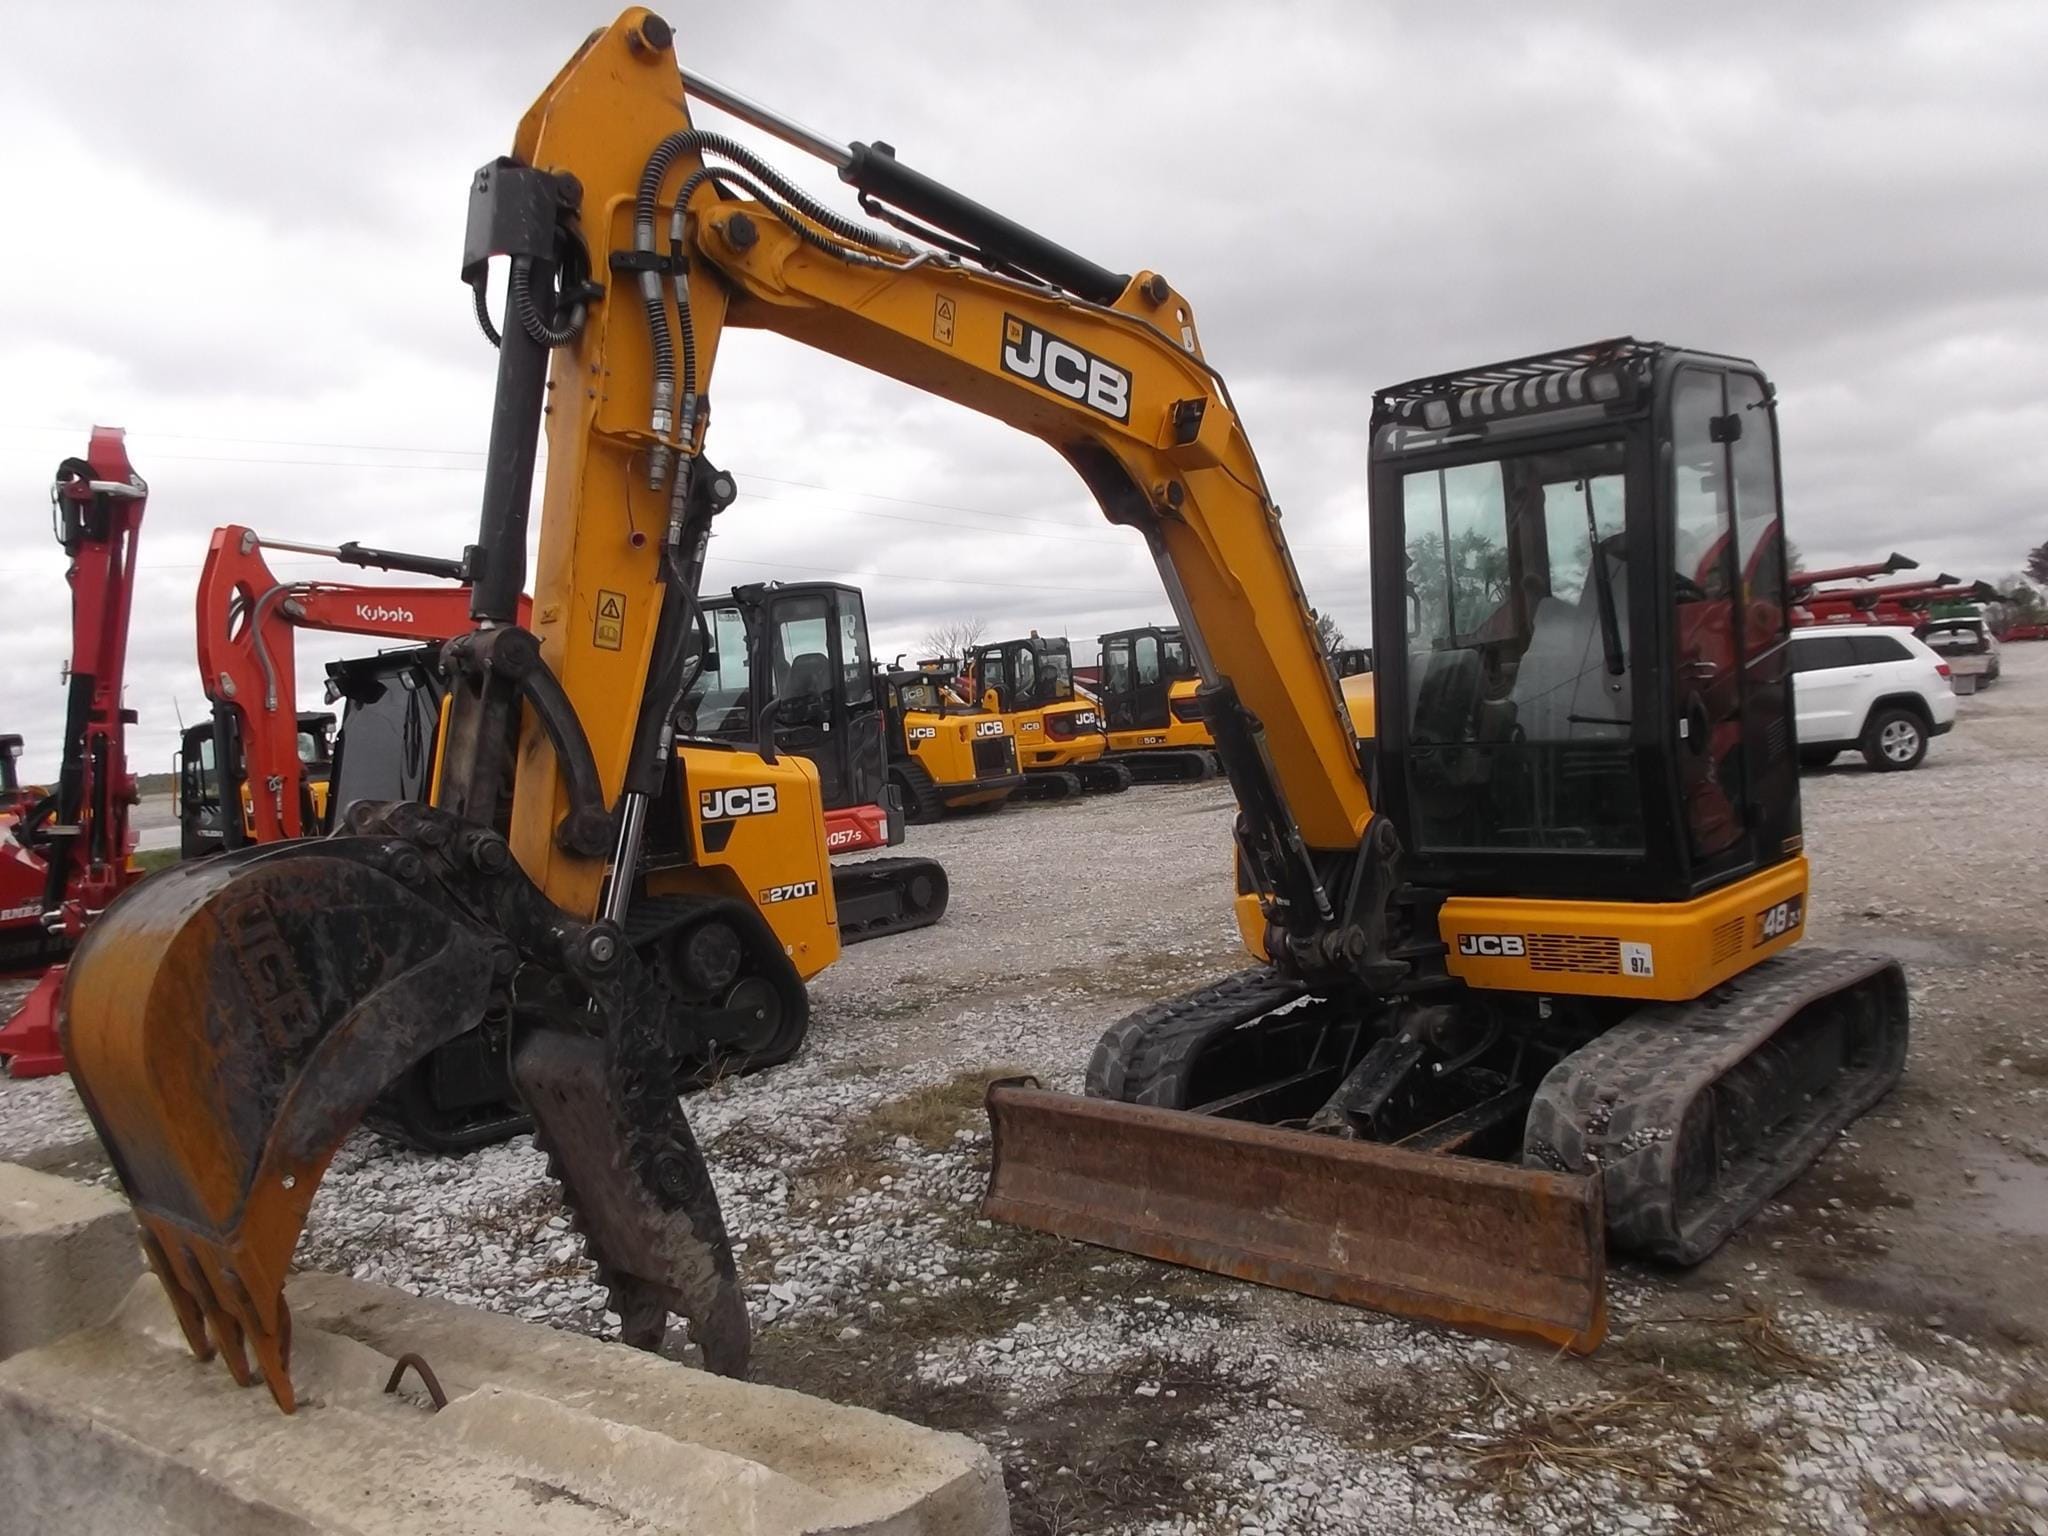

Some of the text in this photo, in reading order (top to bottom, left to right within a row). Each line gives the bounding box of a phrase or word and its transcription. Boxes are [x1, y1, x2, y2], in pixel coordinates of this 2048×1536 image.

[1005, 330, 1128, 418] JCB
[356, 604, 414, 622] Kubota
[902, 688, 924, 701] JCB
[909, 728, 936, 738] JCB
[976, 722, 1004, 736] JCB
[1021, 723, 1040, 731] JCB
[702, 786, 777, 819] JCB
[770, 881, 817, 902] 270T
[1764, 903, 1788, 936] 48
[1460, 935, 1526, 956] JCB
